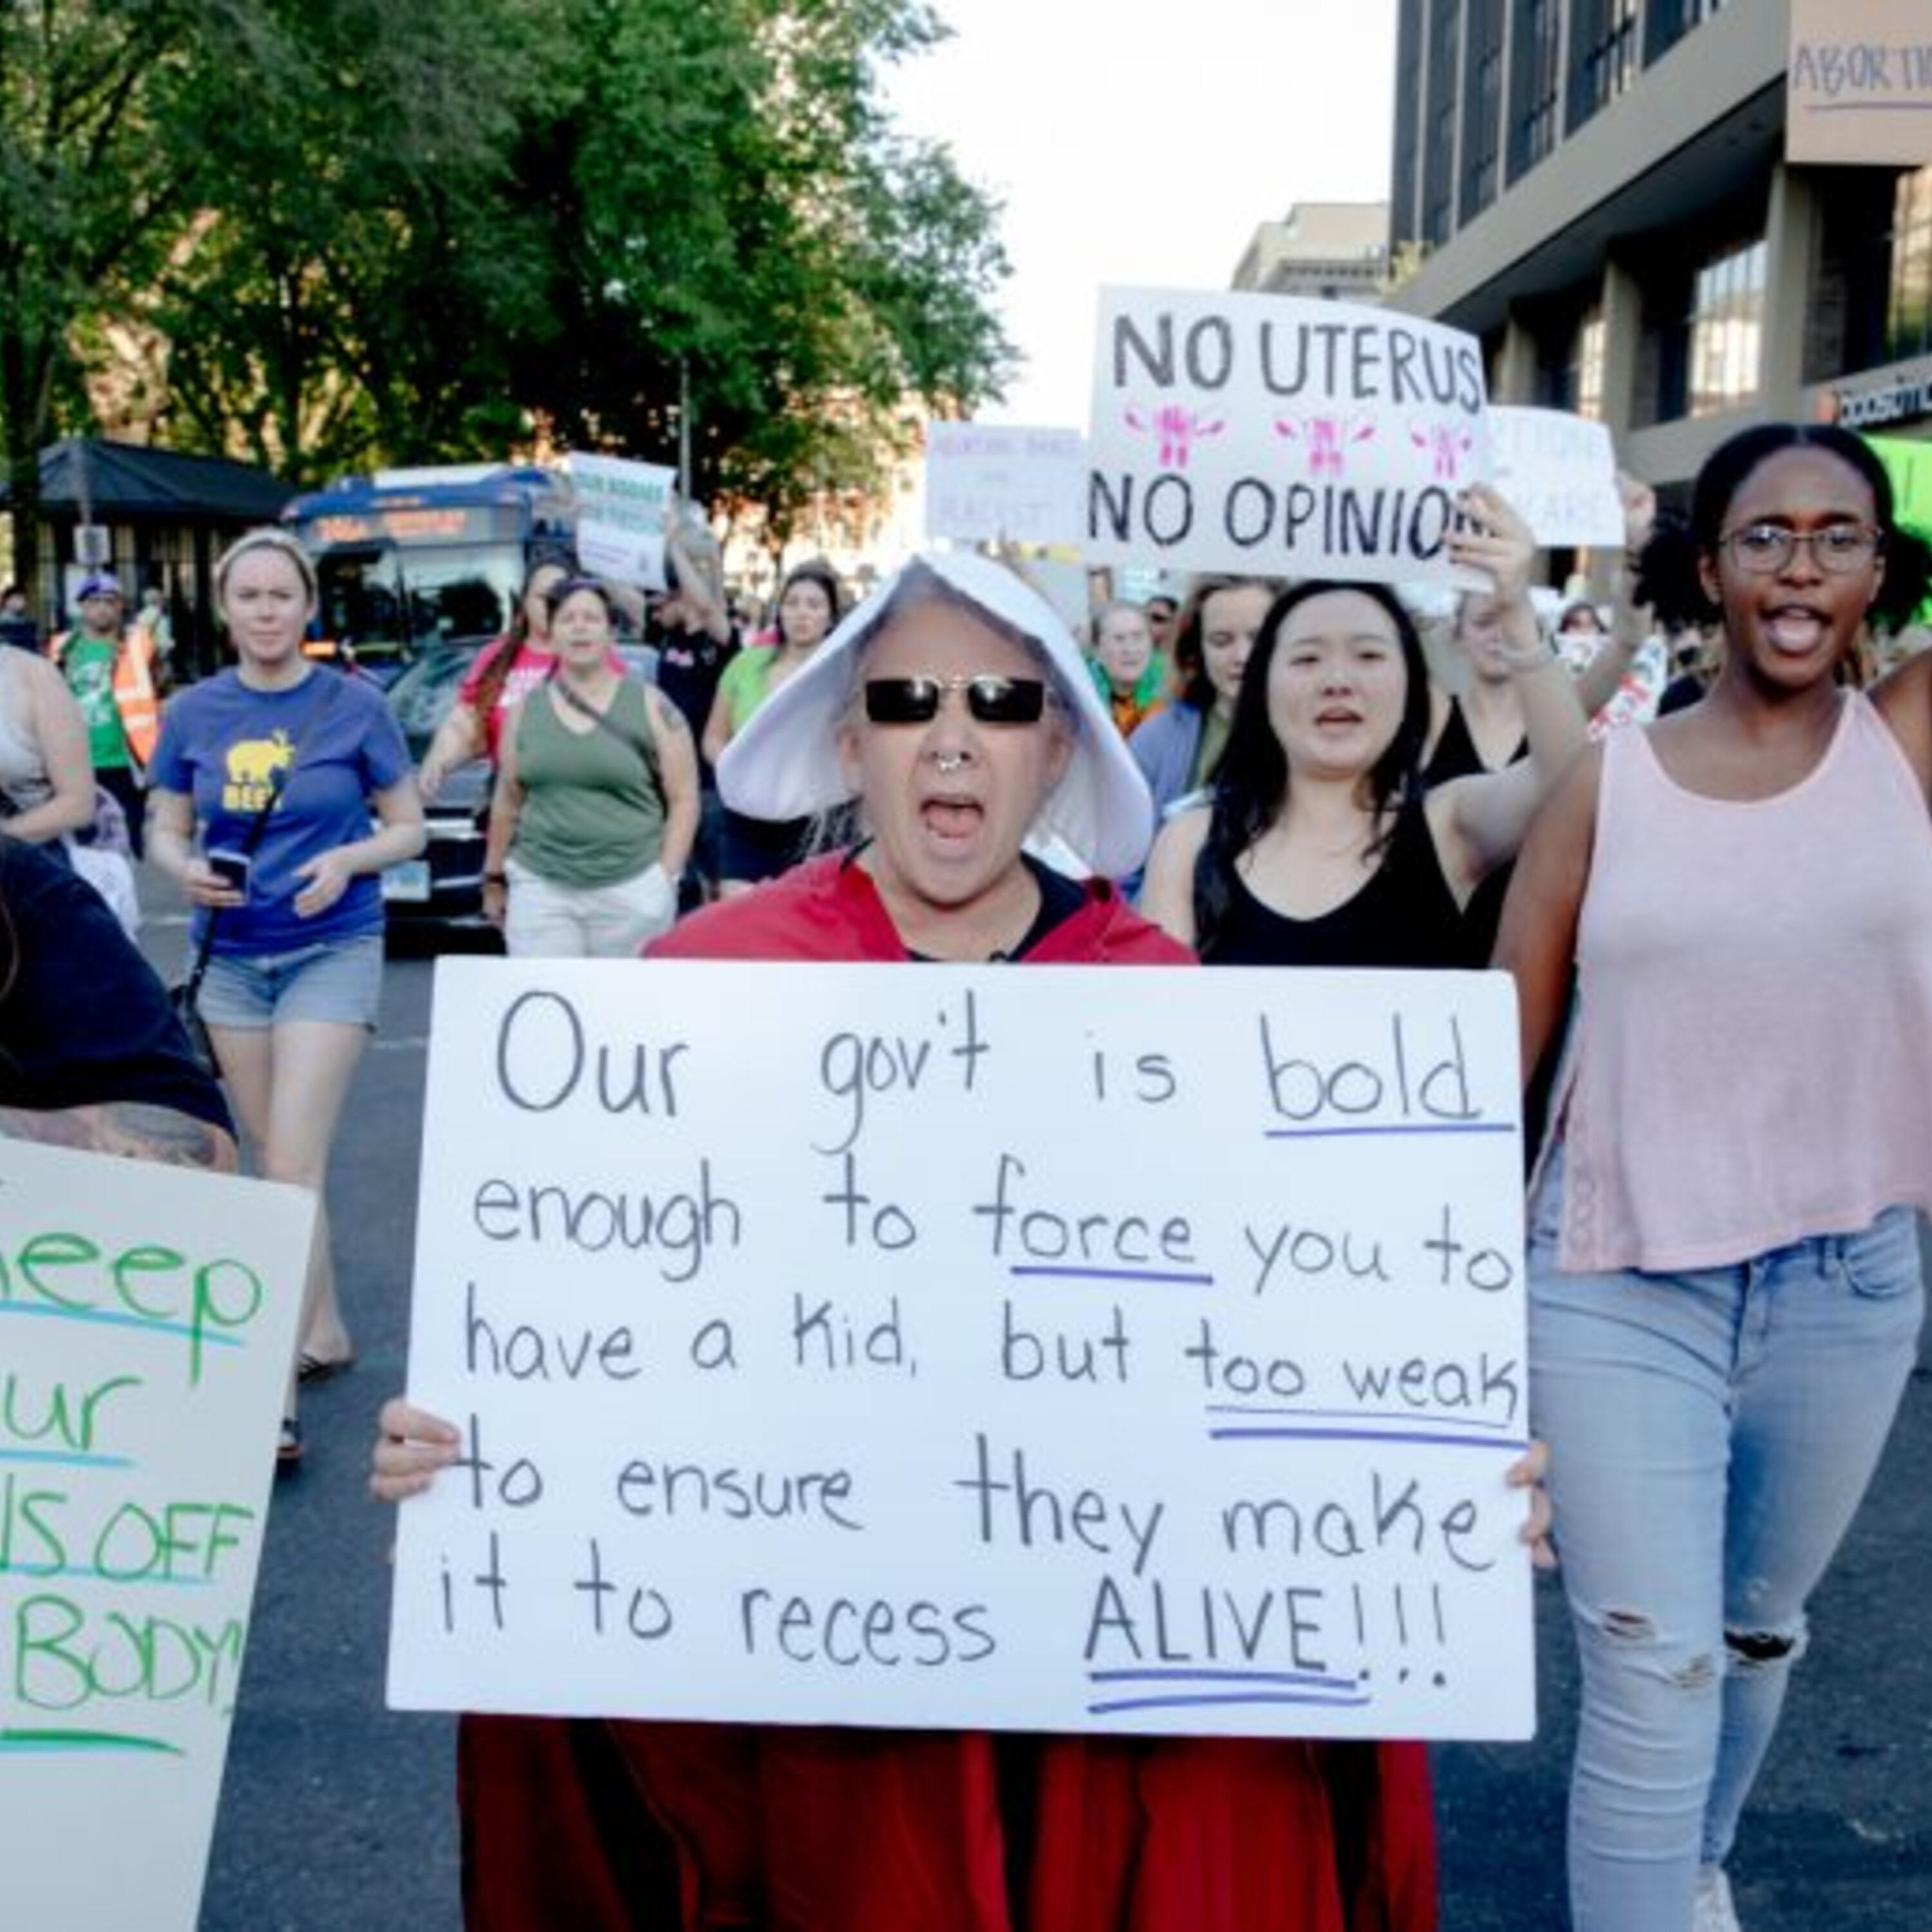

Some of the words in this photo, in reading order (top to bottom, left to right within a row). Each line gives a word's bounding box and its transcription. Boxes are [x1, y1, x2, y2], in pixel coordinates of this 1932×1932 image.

[1114, 314, 1233, 391] NO
[1259, 321, 1481, 417] UTERUS
[1088, 469, 1194, 548] NO
[496, 989, 689, 1118] Our
[811, 989, 990, 1155] gov't
[1086, 1030, 1177, 1104] is
[1260, 1012, 1483, 1121] bold
[474, 1158, 741, 1283] enough
[822, 1151, 917, 1251] to
[971, 1153, 1195, 1264] force
[1244, 1224, 1390, 1296] you
[1423, 1204, 1513, 1293] to
[0, 1233, 260, 1388] eep
[464, 1281, 642, 1381] have
[690, 1319, 737, 1370] a
[1001, 1299, 1130, 1383] but
[1183, 1317, 1306, 1398] too
[95, 1502, 255, 1581] OFF
[444, 1413, 544, 1510] to
[617, 1459, 864, 1531] ensure
[952, 1432, 1164, 1578] they
[440, 1530, 507, 1633] it
[573, 1538, 673, 1641] to
[741, 1588, 996, 1667] recess
[1083, 1575, 1446, 1687] ALIVE!!!
